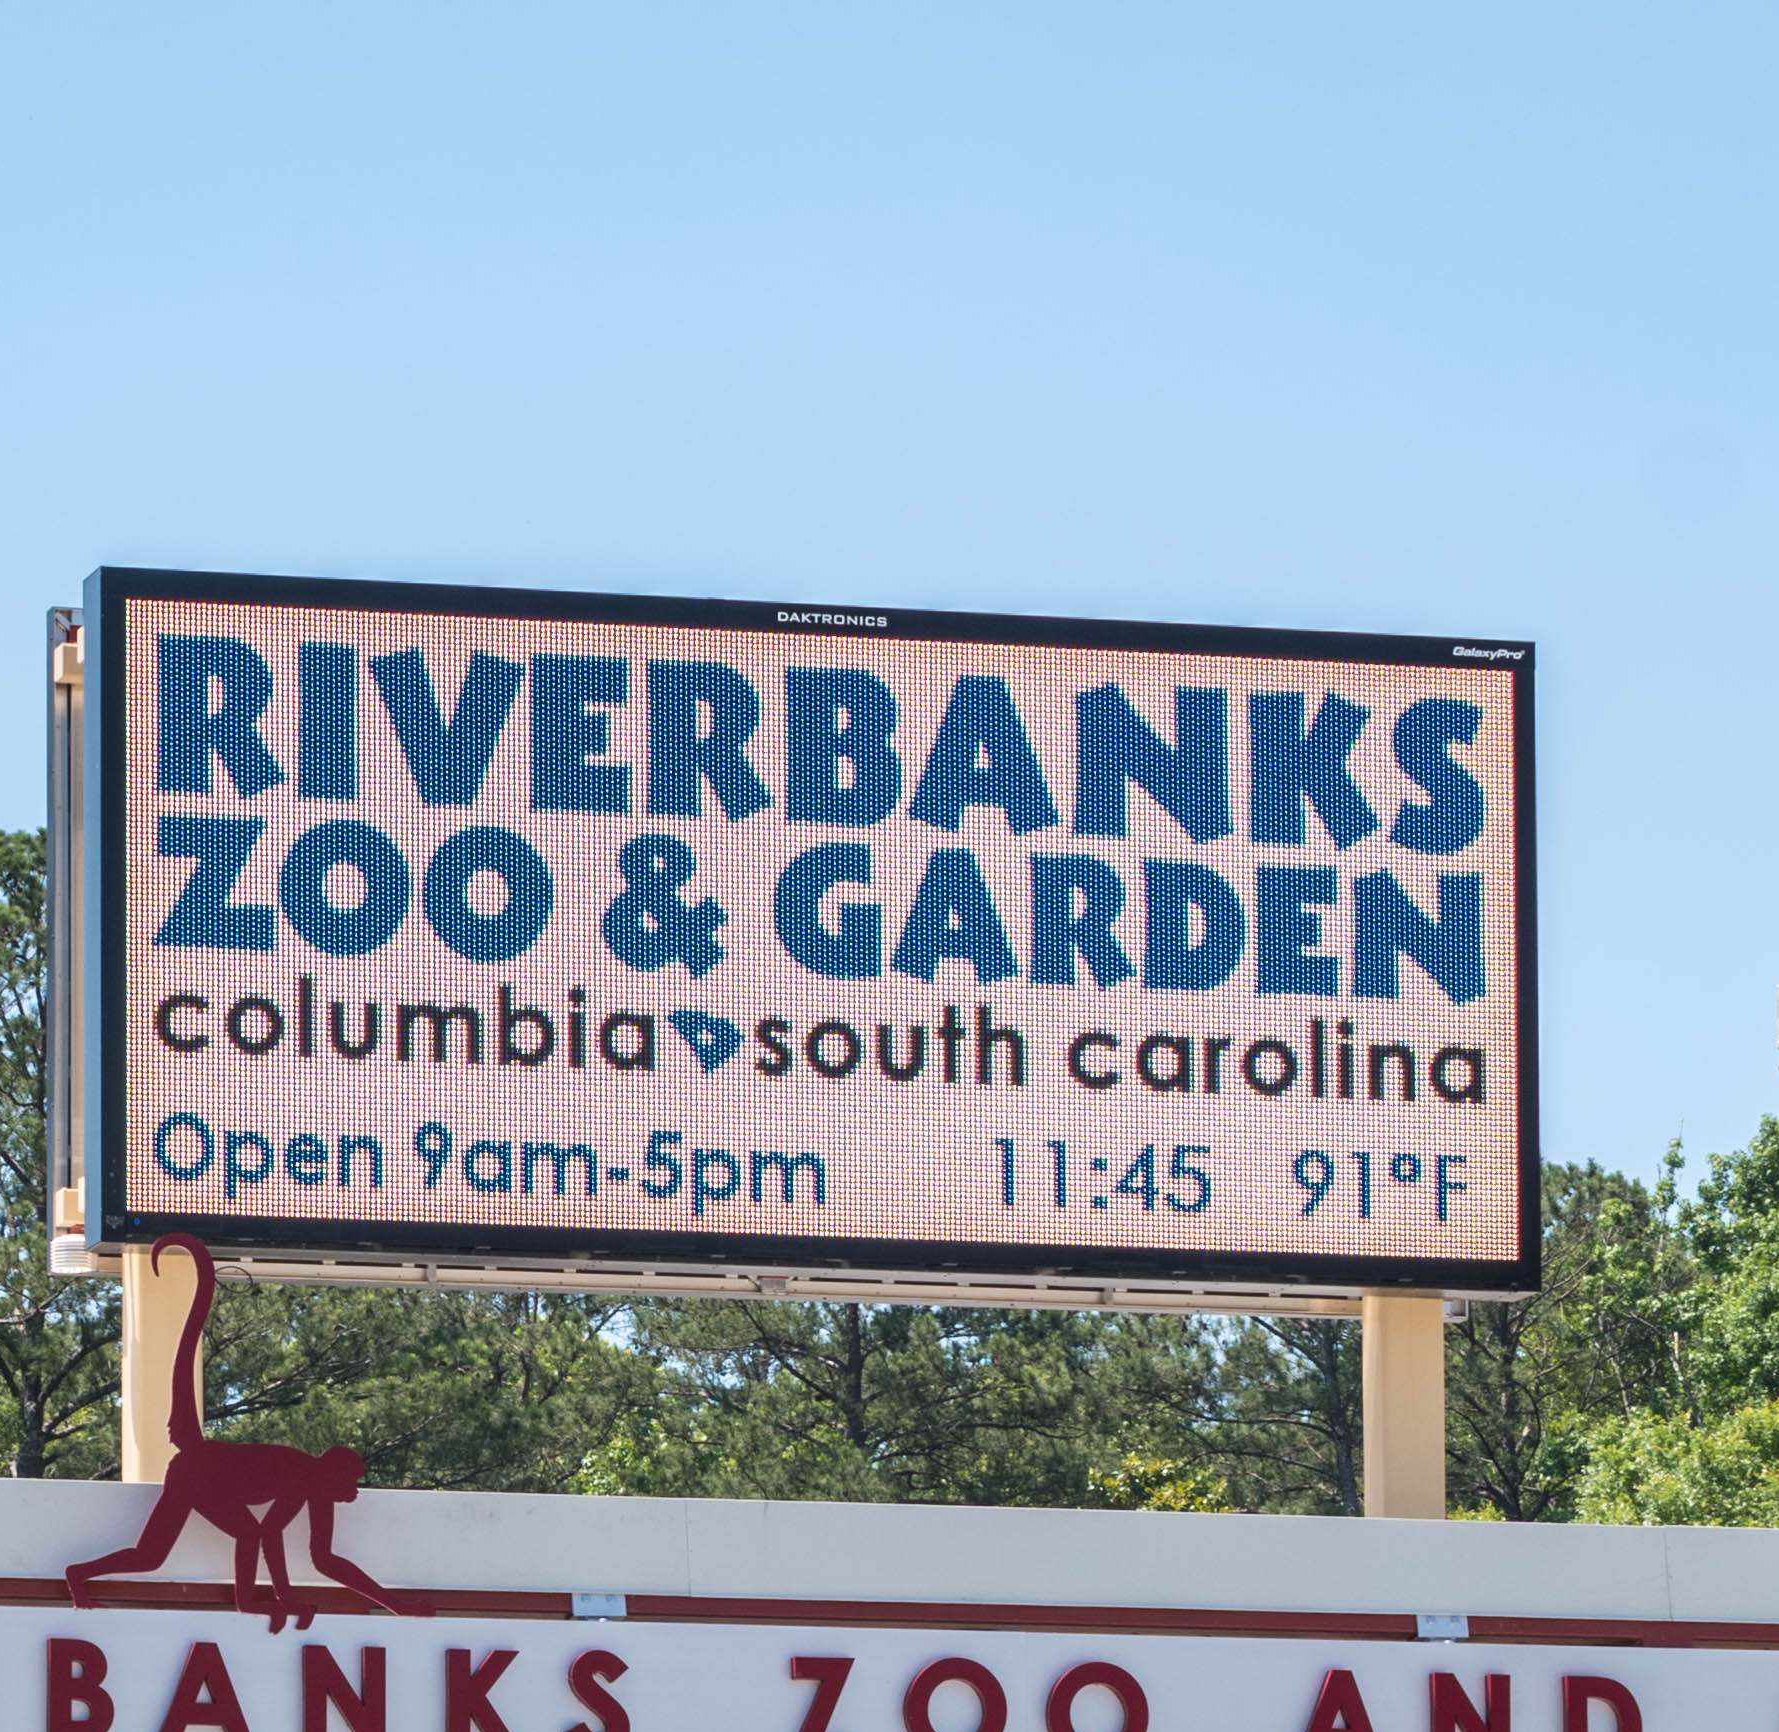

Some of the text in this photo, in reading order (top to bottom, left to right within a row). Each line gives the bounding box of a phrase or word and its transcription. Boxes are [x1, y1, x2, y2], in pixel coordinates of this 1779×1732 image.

[777, 611, 888, 627] DAKTRONICS
[156, 634, 1484, 854] RIVERBANKS
[153, 815, 1485, 1003] ZOO & GARDEN
[153, 975, 1485, 1105] columbia south carolina
[153, 1113, 825, 1215] Open 9am-5pm
[998, 1138, 1212, 1214] 11:45
